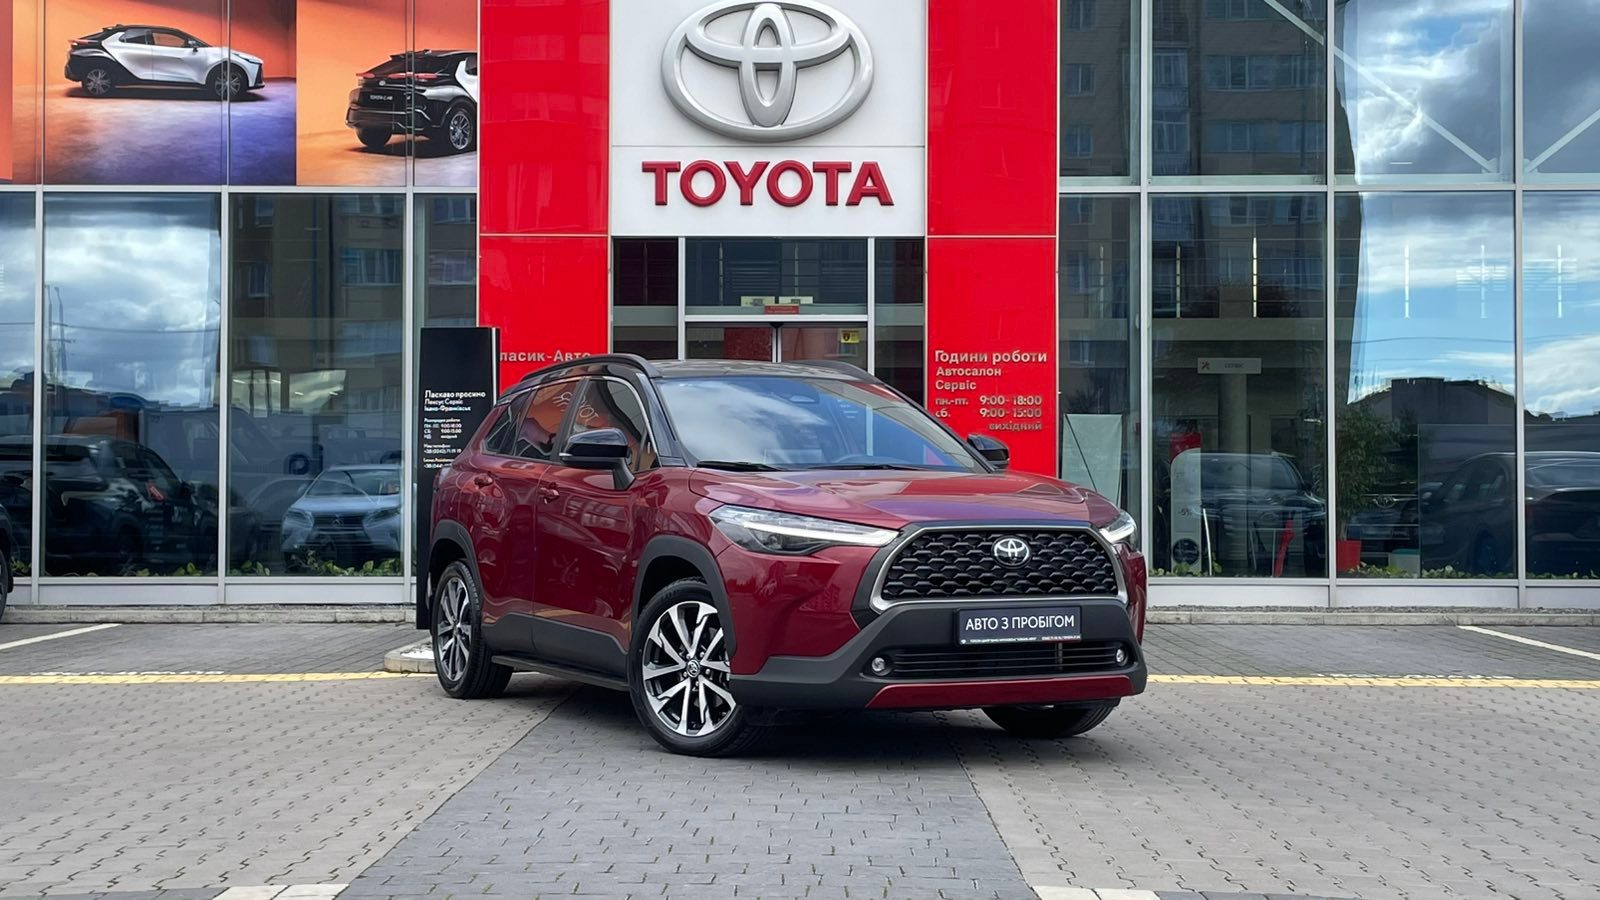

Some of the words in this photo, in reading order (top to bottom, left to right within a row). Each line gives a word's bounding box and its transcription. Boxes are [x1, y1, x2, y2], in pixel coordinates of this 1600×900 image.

[642, 160, 894, 207] TOYOTA
[935, 350, 988, 364] Години
[992, 350, 1047, 365] роботи
[936, 366, 1002, 377] Автосалон
[935, 380, 977, 392] Сервіс
[988, 420, 1042, 431] вихідний
[965, 617, 999, 631] АВТО
[1001, 617, 1009, 630] З
[1012, 614, 1075, 629] ПРОБІГОМ
